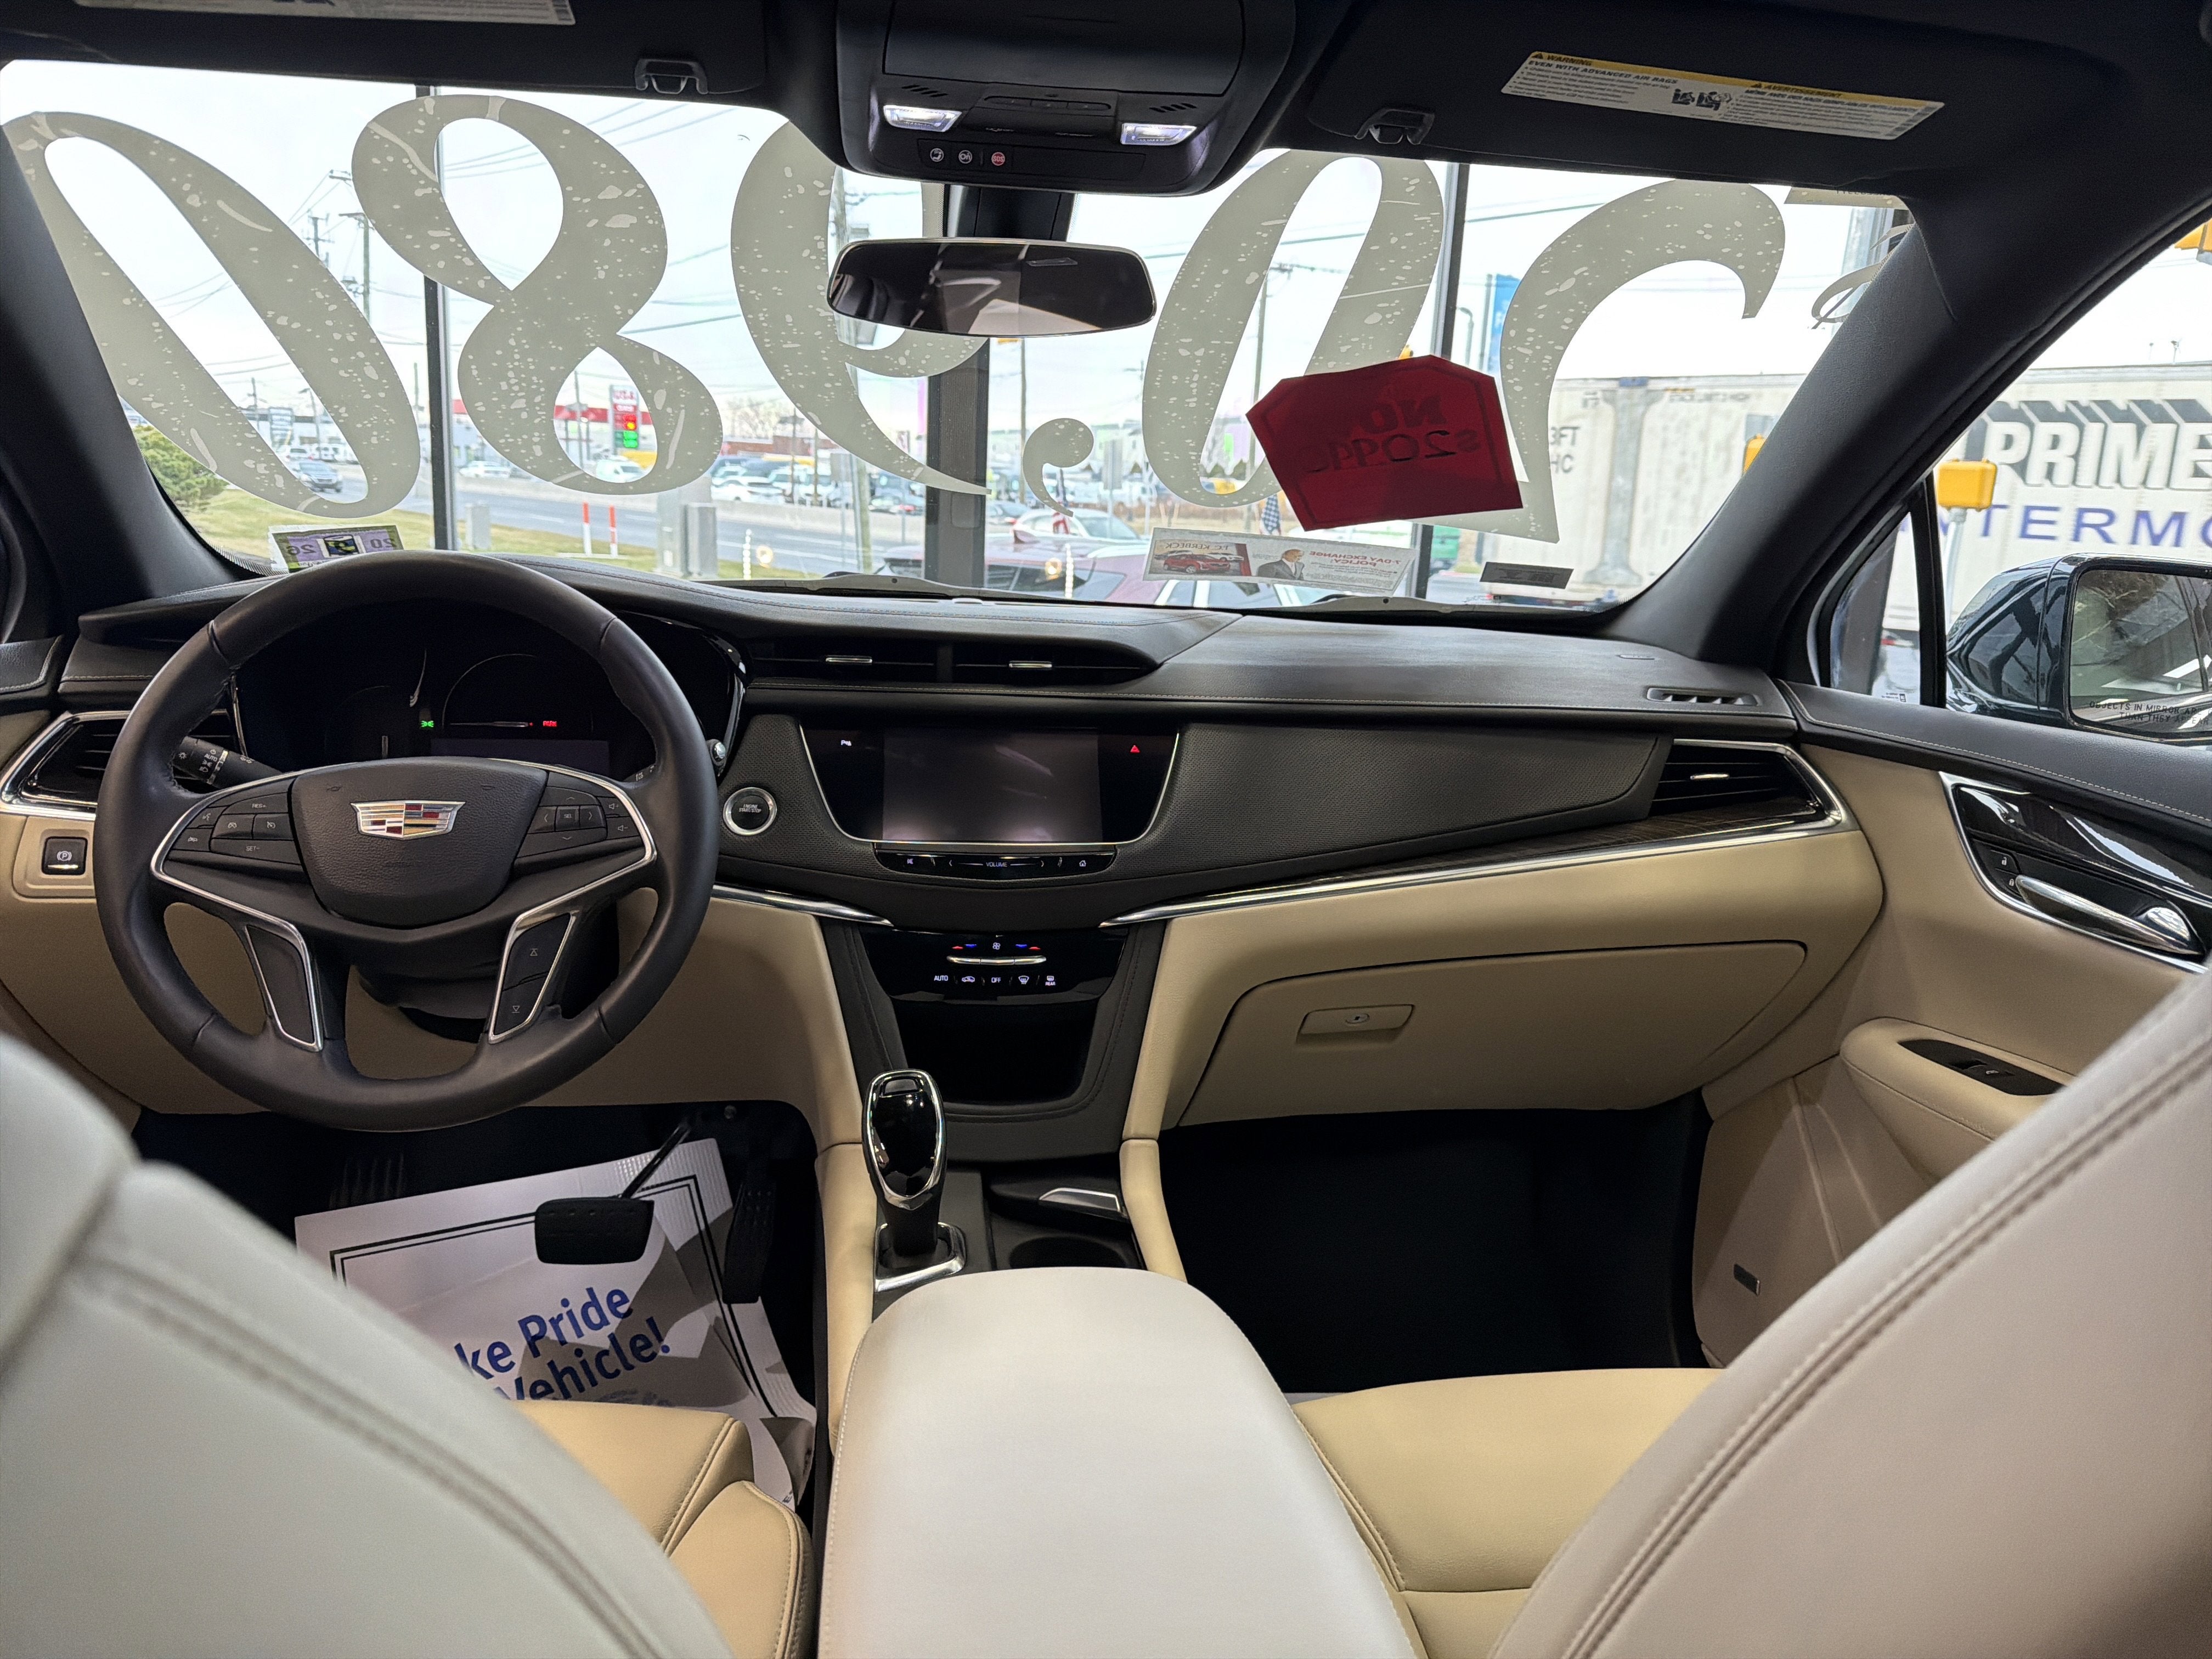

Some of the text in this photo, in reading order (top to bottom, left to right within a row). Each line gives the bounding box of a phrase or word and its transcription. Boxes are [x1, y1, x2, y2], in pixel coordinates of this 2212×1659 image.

[1547, 55, 1592, 66] WARNING
[1528, 60, 1553, 68] EVEN
[1555, 63, 1580, 71] WITH
[1582, 66, 1632, 79] ADVANCED
[1979, 411, 2212, 490] PRIME
[2134, 703, 2143, 712] IN
[204, 753, 218, 762] AUTO
[518, 1286, 634, 1358] Pride
